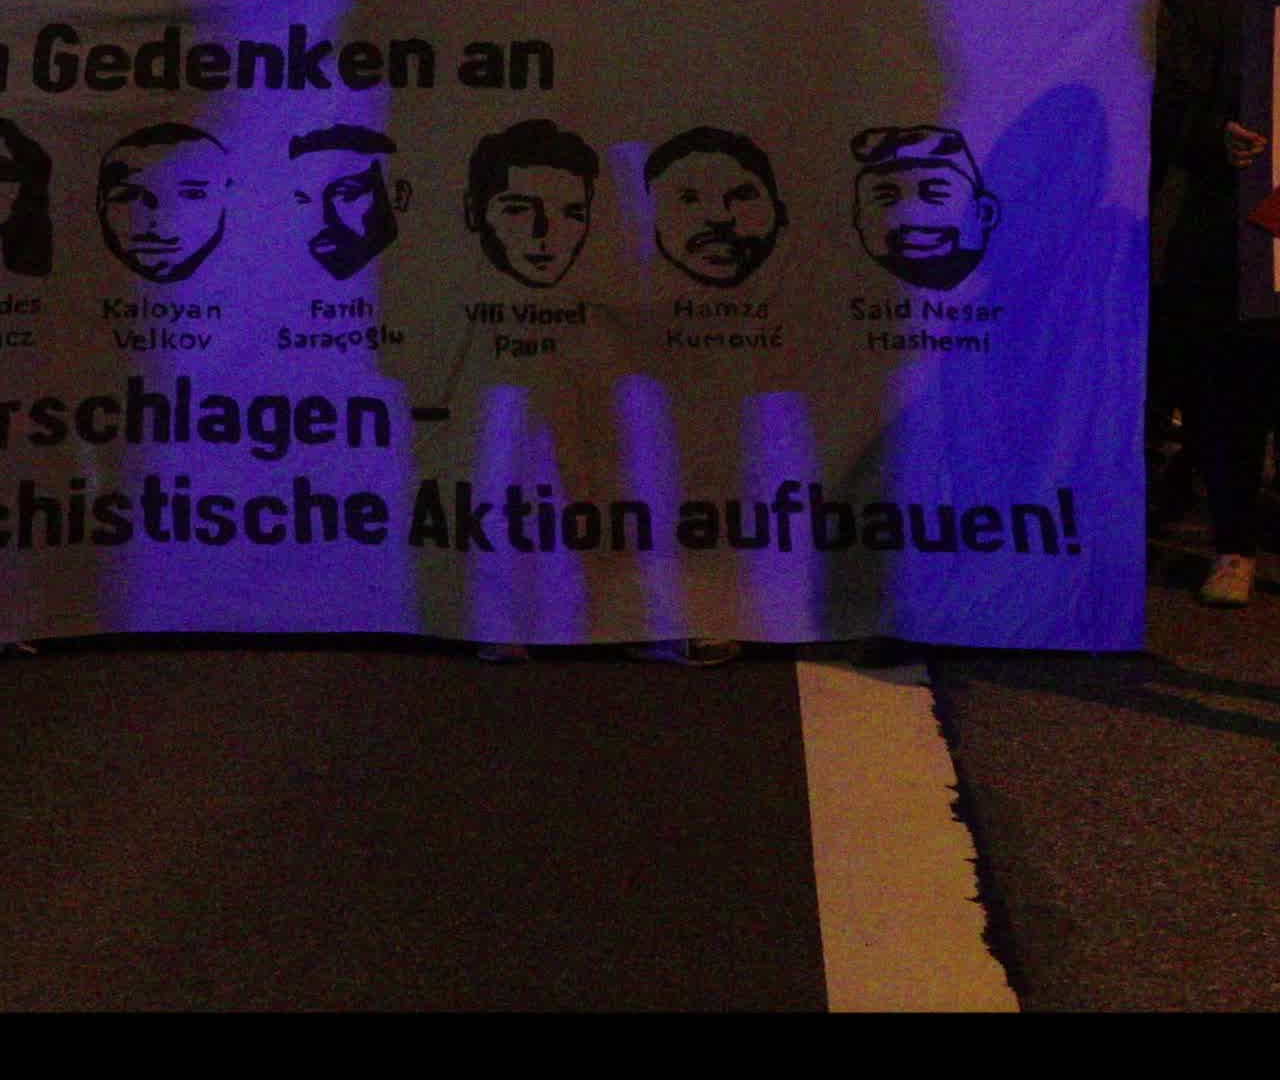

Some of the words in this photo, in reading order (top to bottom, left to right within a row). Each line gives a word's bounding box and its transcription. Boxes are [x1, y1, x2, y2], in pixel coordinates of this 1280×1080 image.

[31, 23, 436, 94] Gedenken
[457, 38, 554, 91] an
[102, 297, 221, 322] Kaloyan
[849, 297, 912, 321] Said
[112, 328, 213, 351] Velkov
[866, 329, 991, 353] Hashemi
[408, 478, 654, 553] Aktion
[674, 478, 1082, 556] aufbauen!
